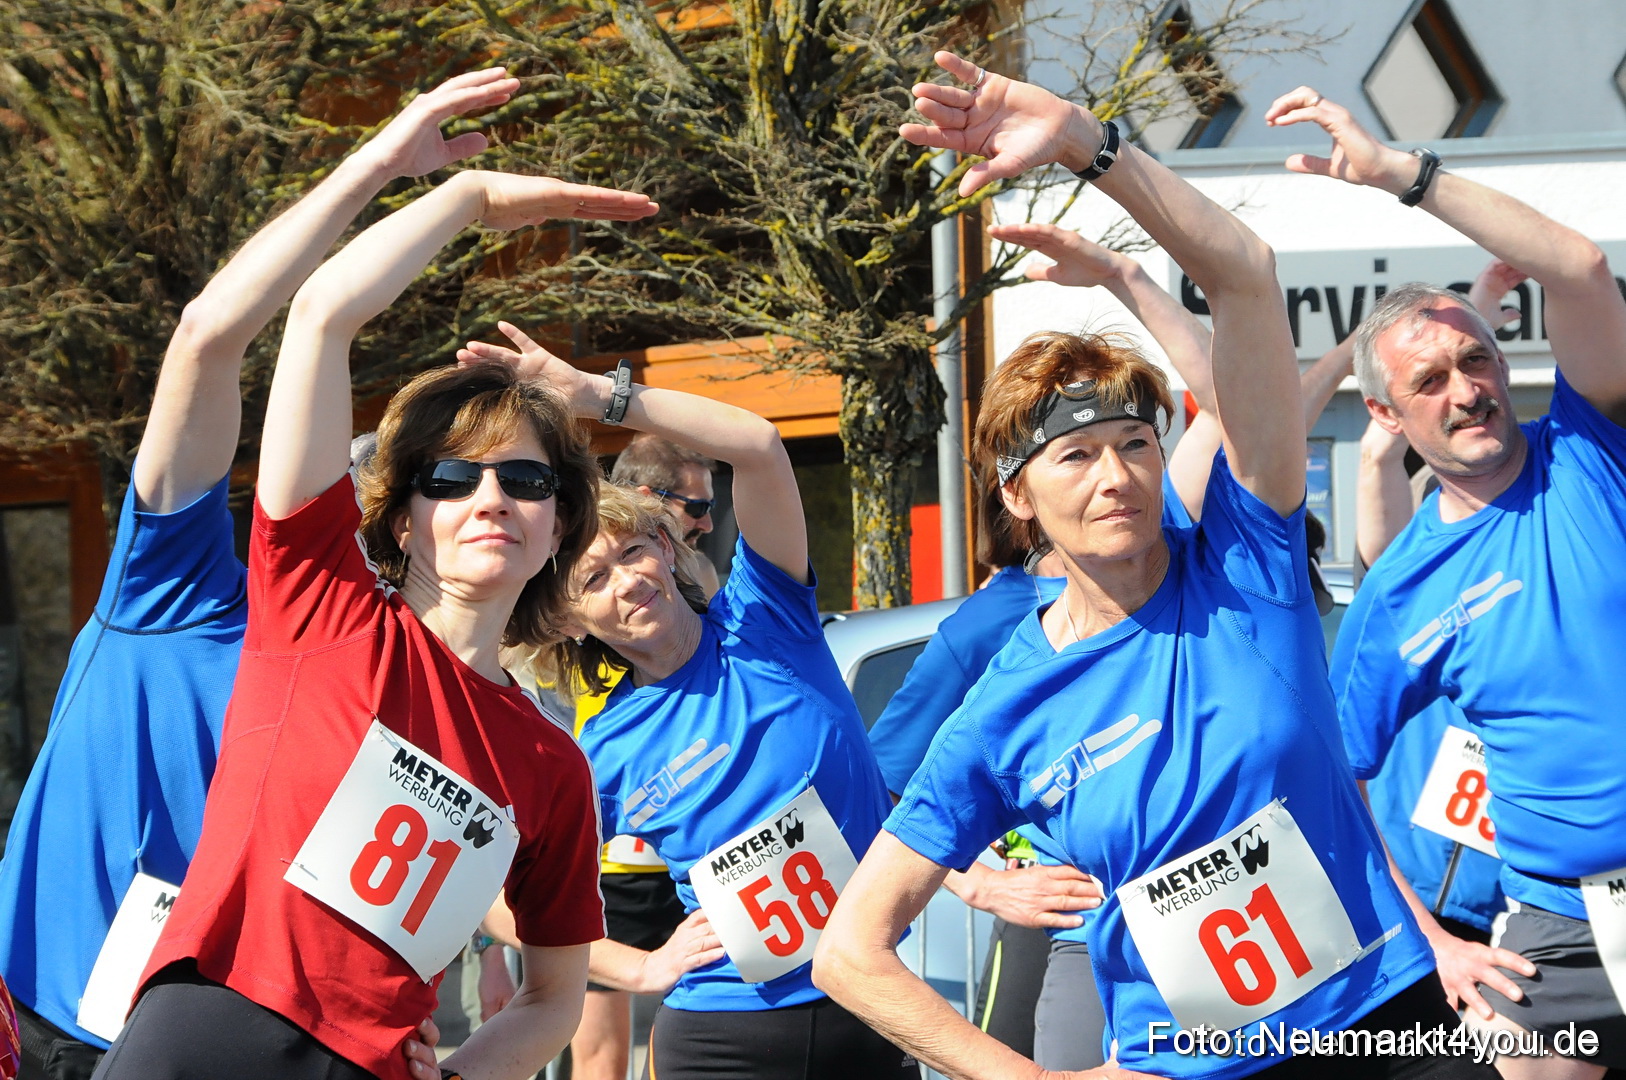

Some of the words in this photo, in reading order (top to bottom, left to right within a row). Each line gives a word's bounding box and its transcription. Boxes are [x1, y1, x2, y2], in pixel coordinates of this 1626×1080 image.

[388, 764, 464, 826] WERBUNG
[391, 747, 473, 813] MEYER
[350, 804, 462, 936] 81
[710, 828, 777, 877] MEYER
[717, 843, 783, 887] WERBUNG
[1146, 849, 1233, 904] MEYER
[737, 851, 839, 957] 58
[1154, 866, 1240, 917] WERBUNG
[1198, 883, 1313, 1006] 61
